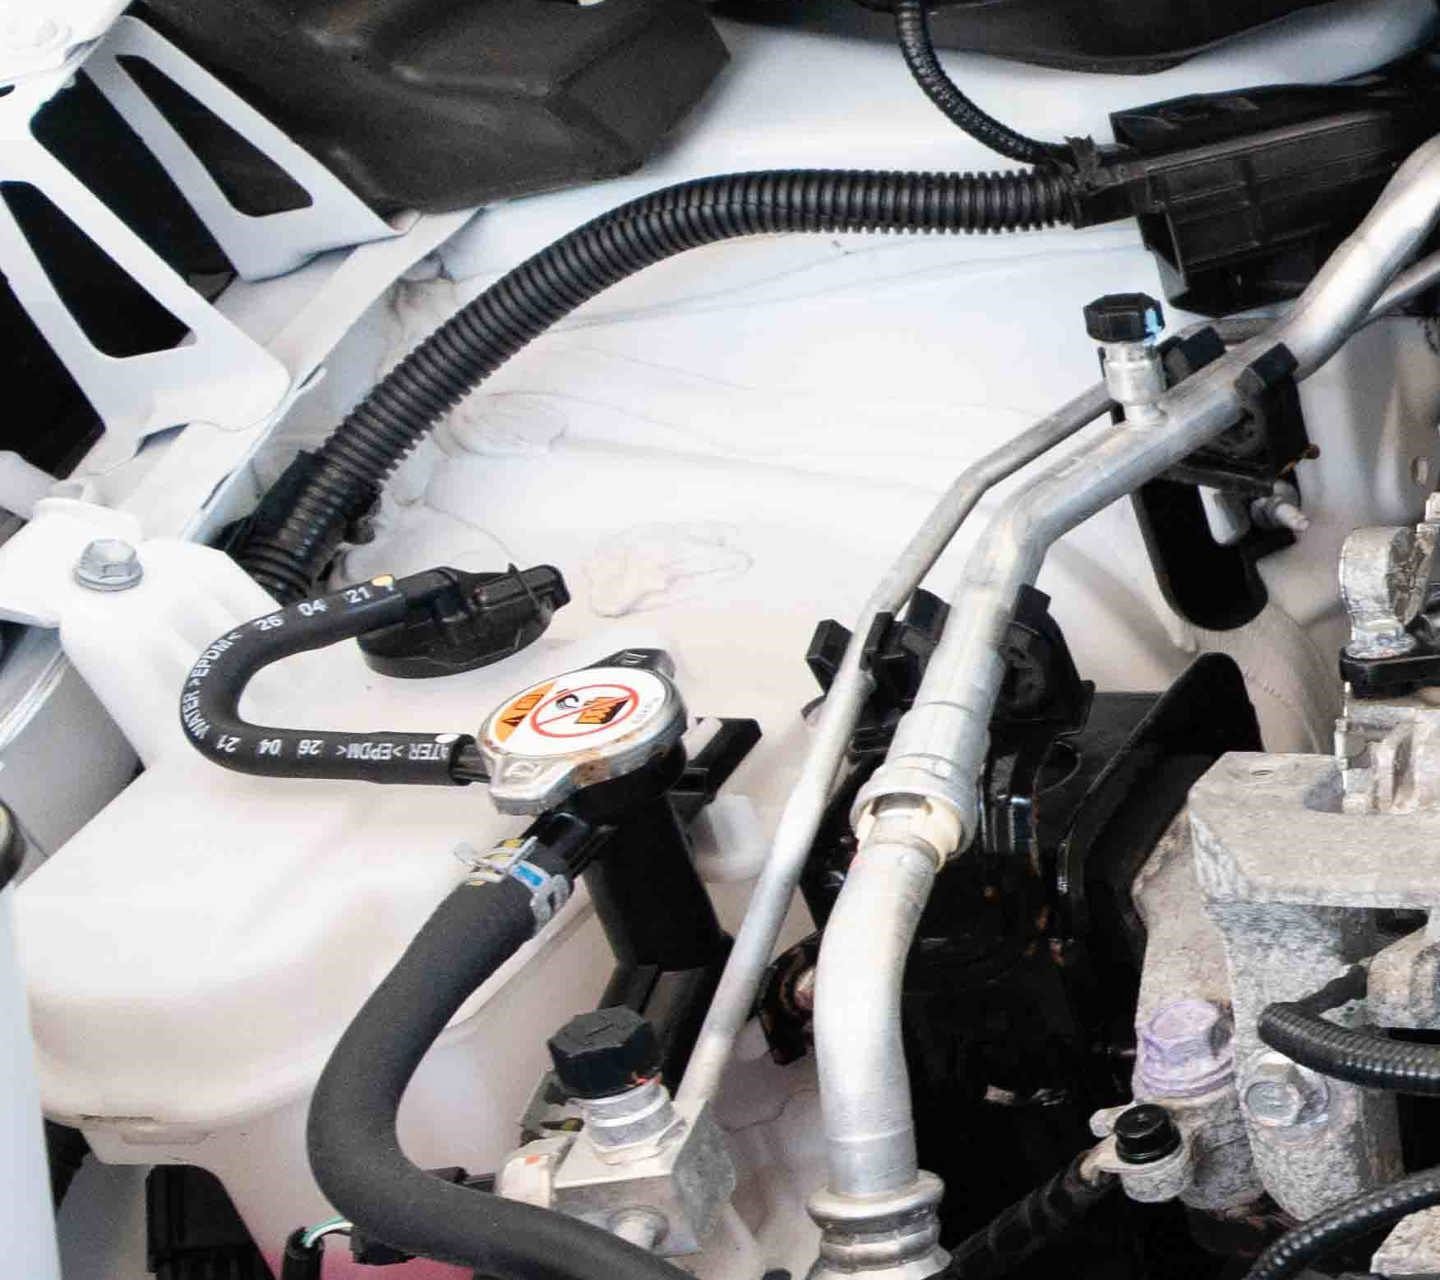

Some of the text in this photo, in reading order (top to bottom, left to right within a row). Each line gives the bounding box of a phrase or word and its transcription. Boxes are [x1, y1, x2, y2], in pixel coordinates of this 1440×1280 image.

[254, 616, 284, 631] 26
[298, 598, 329, 617] 04
[346, 586, 371, 604] 21
[216, 734, 242, 752] 21
[258, 739, 283, 755] 04
[298, 739, 324, 755] 26
[407, 743, 449, 761] ATER
